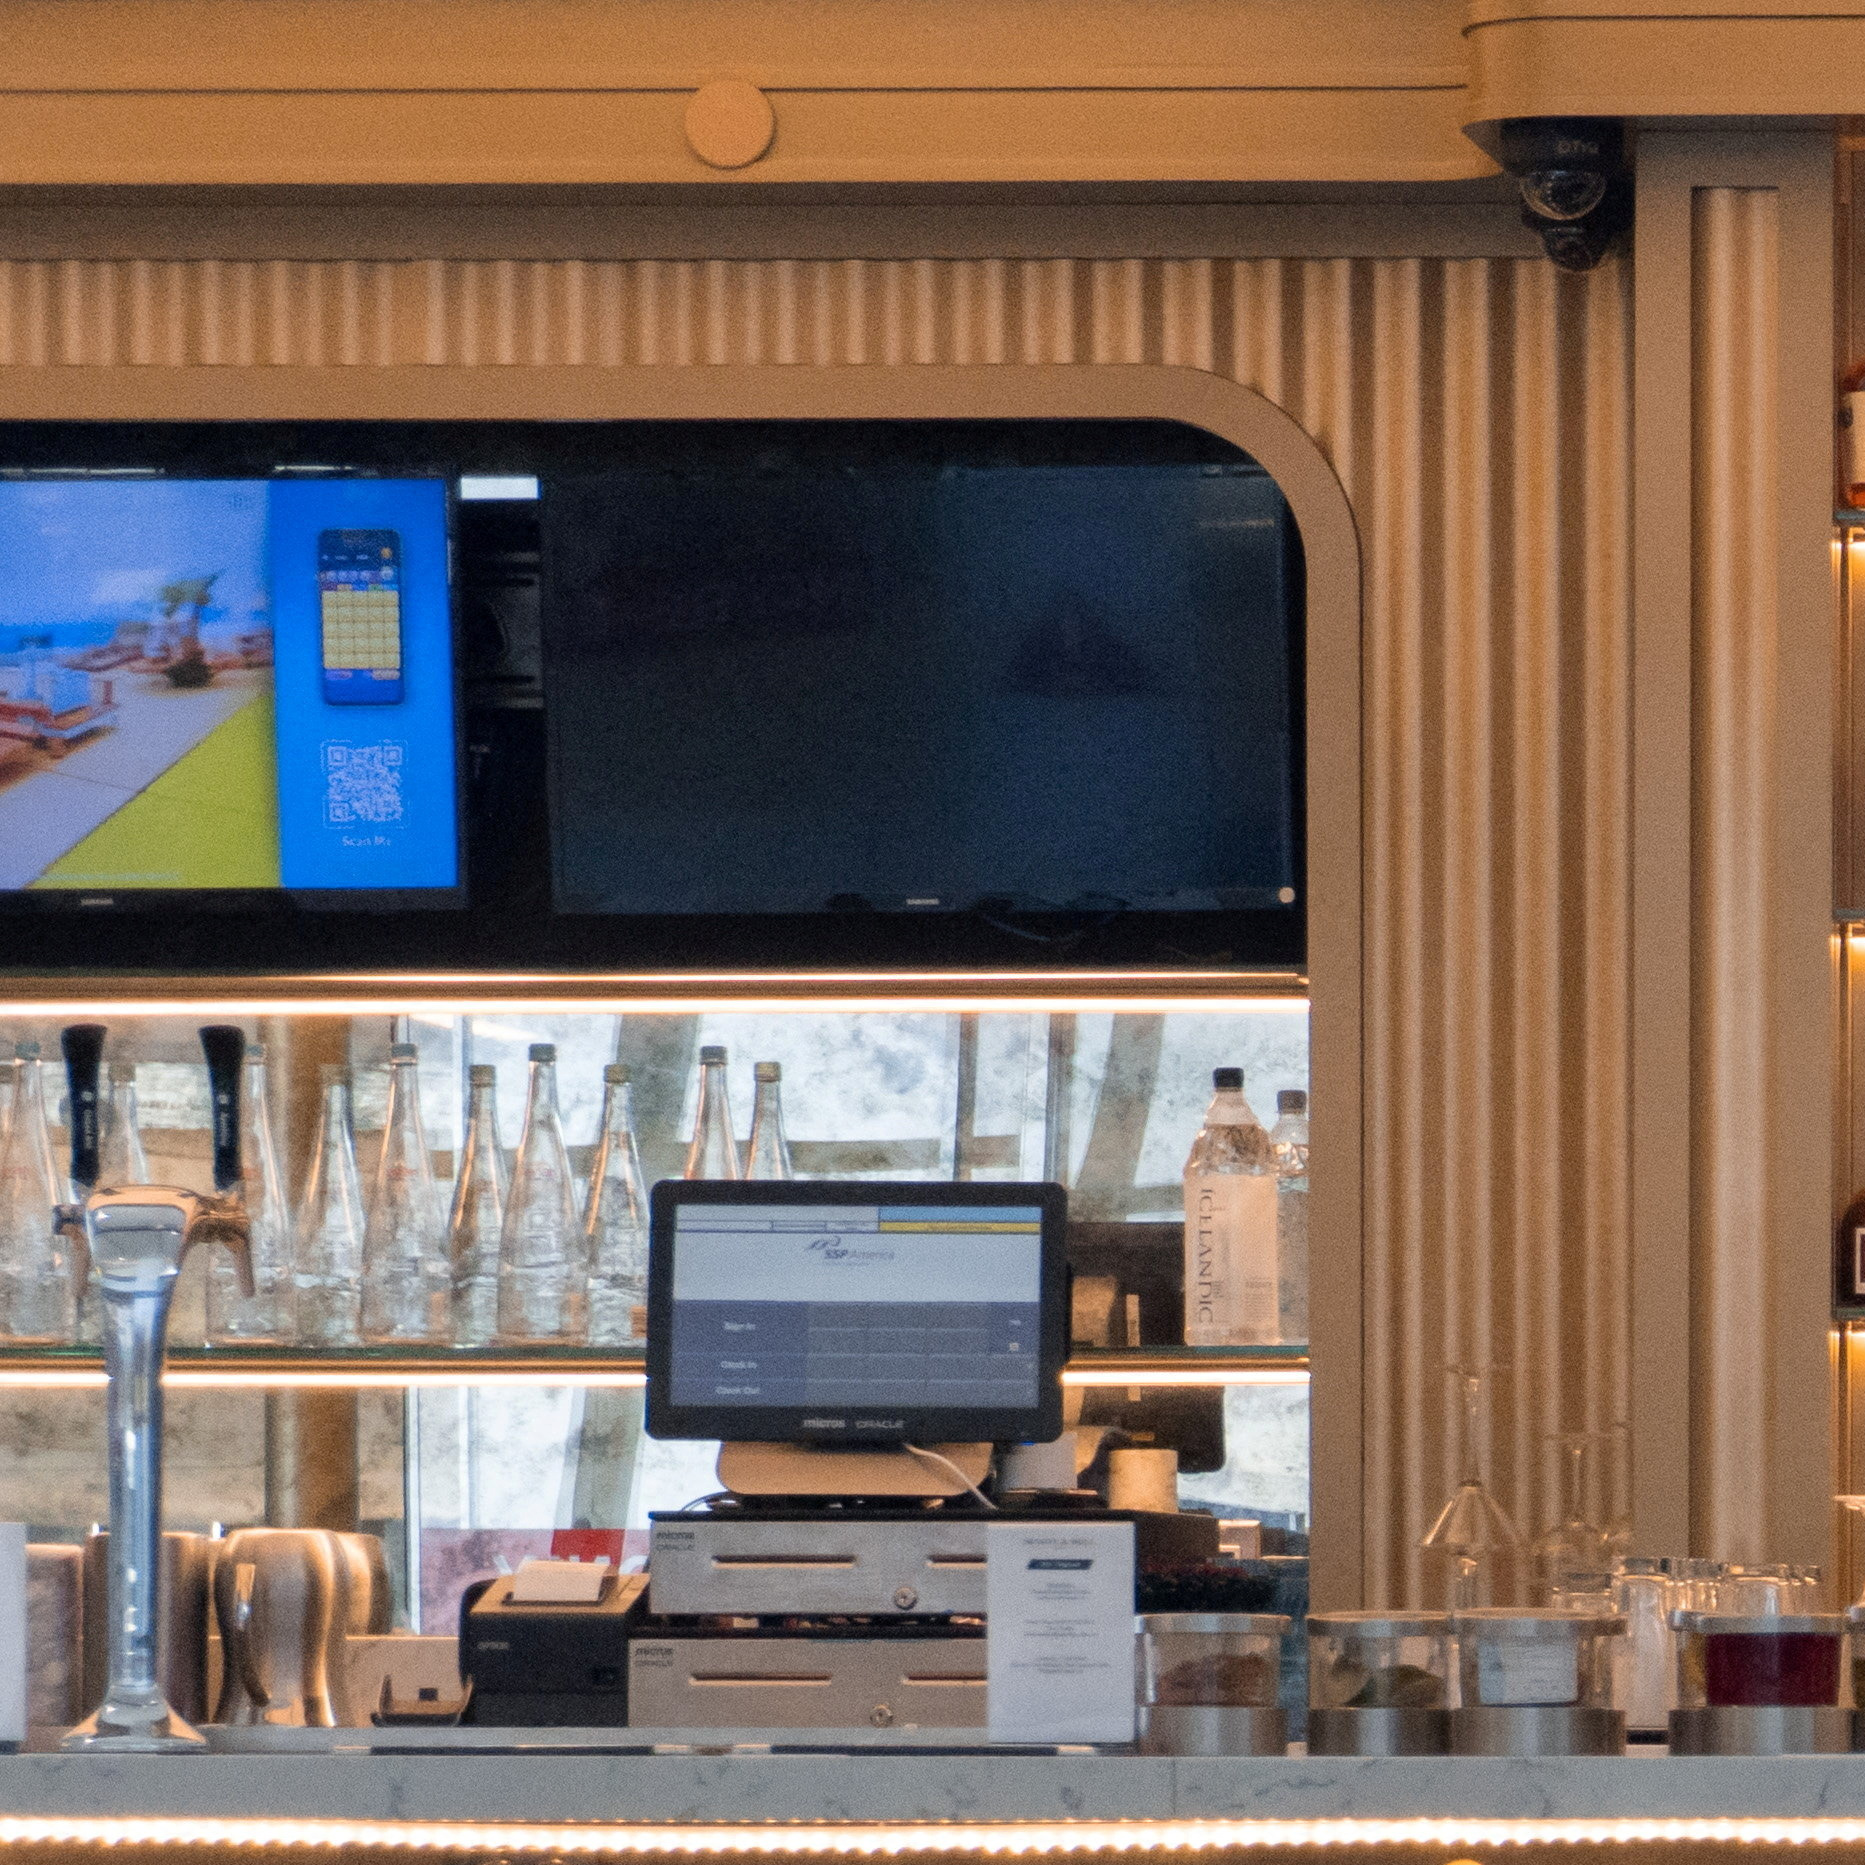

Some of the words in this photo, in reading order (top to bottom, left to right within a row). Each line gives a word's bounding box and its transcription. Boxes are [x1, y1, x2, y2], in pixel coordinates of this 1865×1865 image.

[825, 1249, 849, 1259] SSP
[803, 1418, 846, 1429] micros
[855, 1420, 904, 1429] ORACLE
